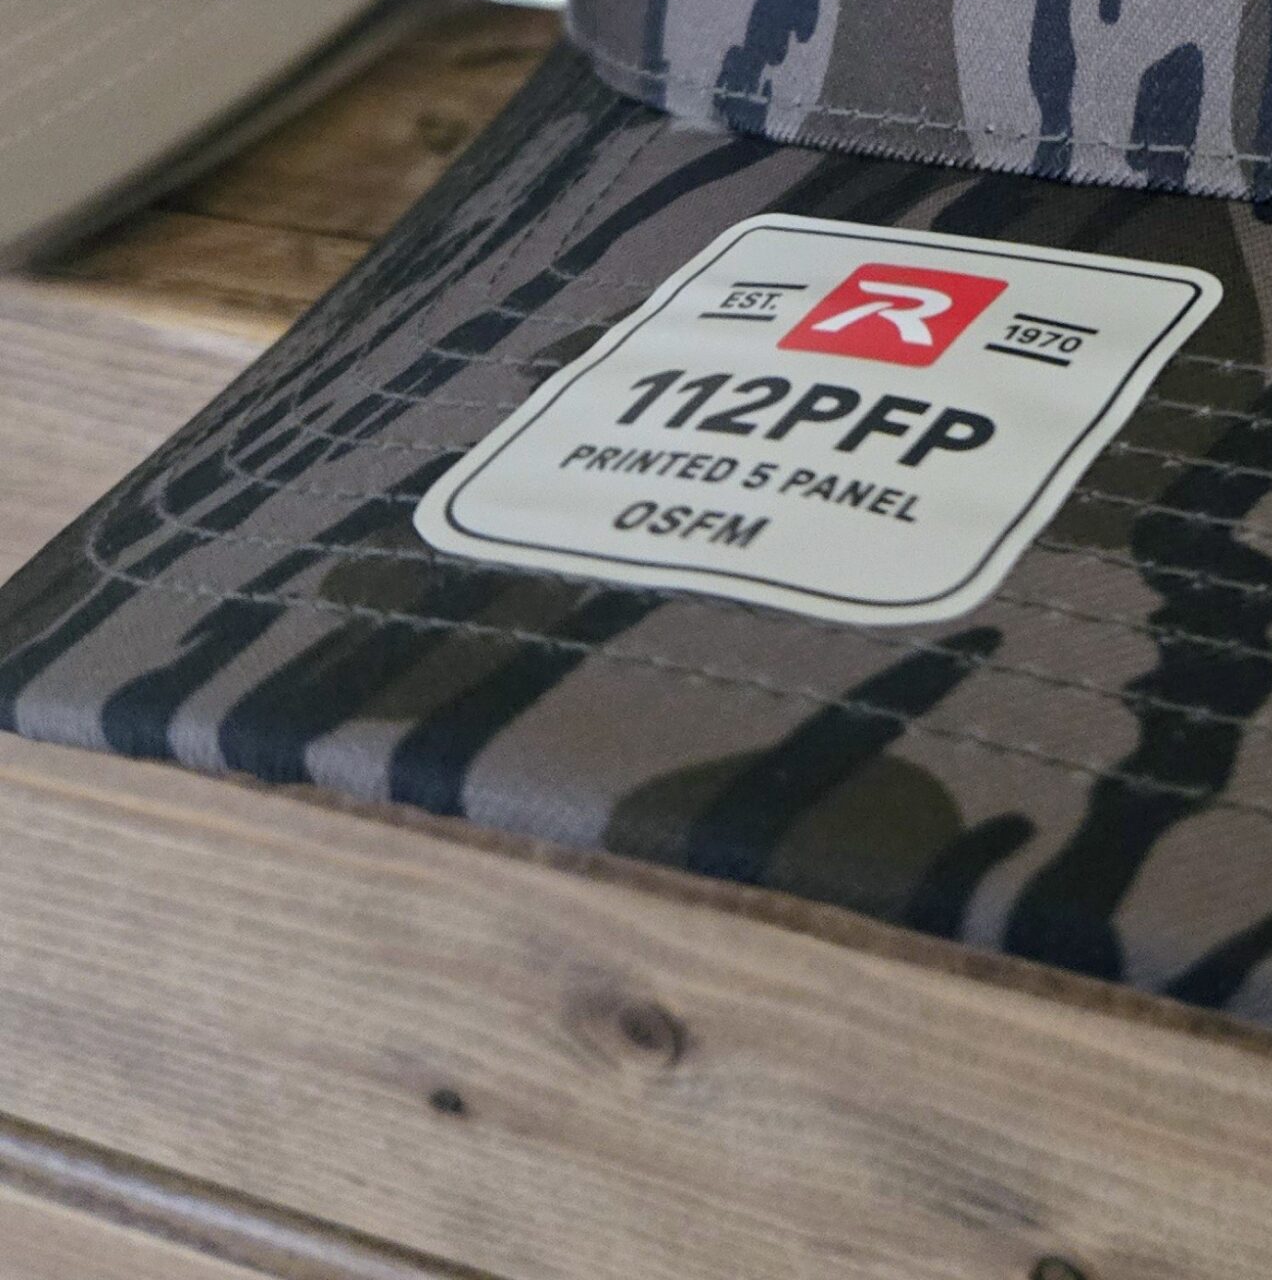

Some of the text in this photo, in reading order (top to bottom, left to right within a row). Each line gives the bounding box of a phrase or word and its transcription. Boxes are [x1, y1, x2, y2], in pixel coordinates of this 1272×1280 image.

[719, 288, 781, 312] EST.
[811, 280, 953, 346] R
[1004, 323, 1083, 355] 1970
[617, 369, 996, 468] 112PFP
[559, 444, 919, 522] PRINTED 5 PANEL
[613, 501, 770, 548] OSFM
